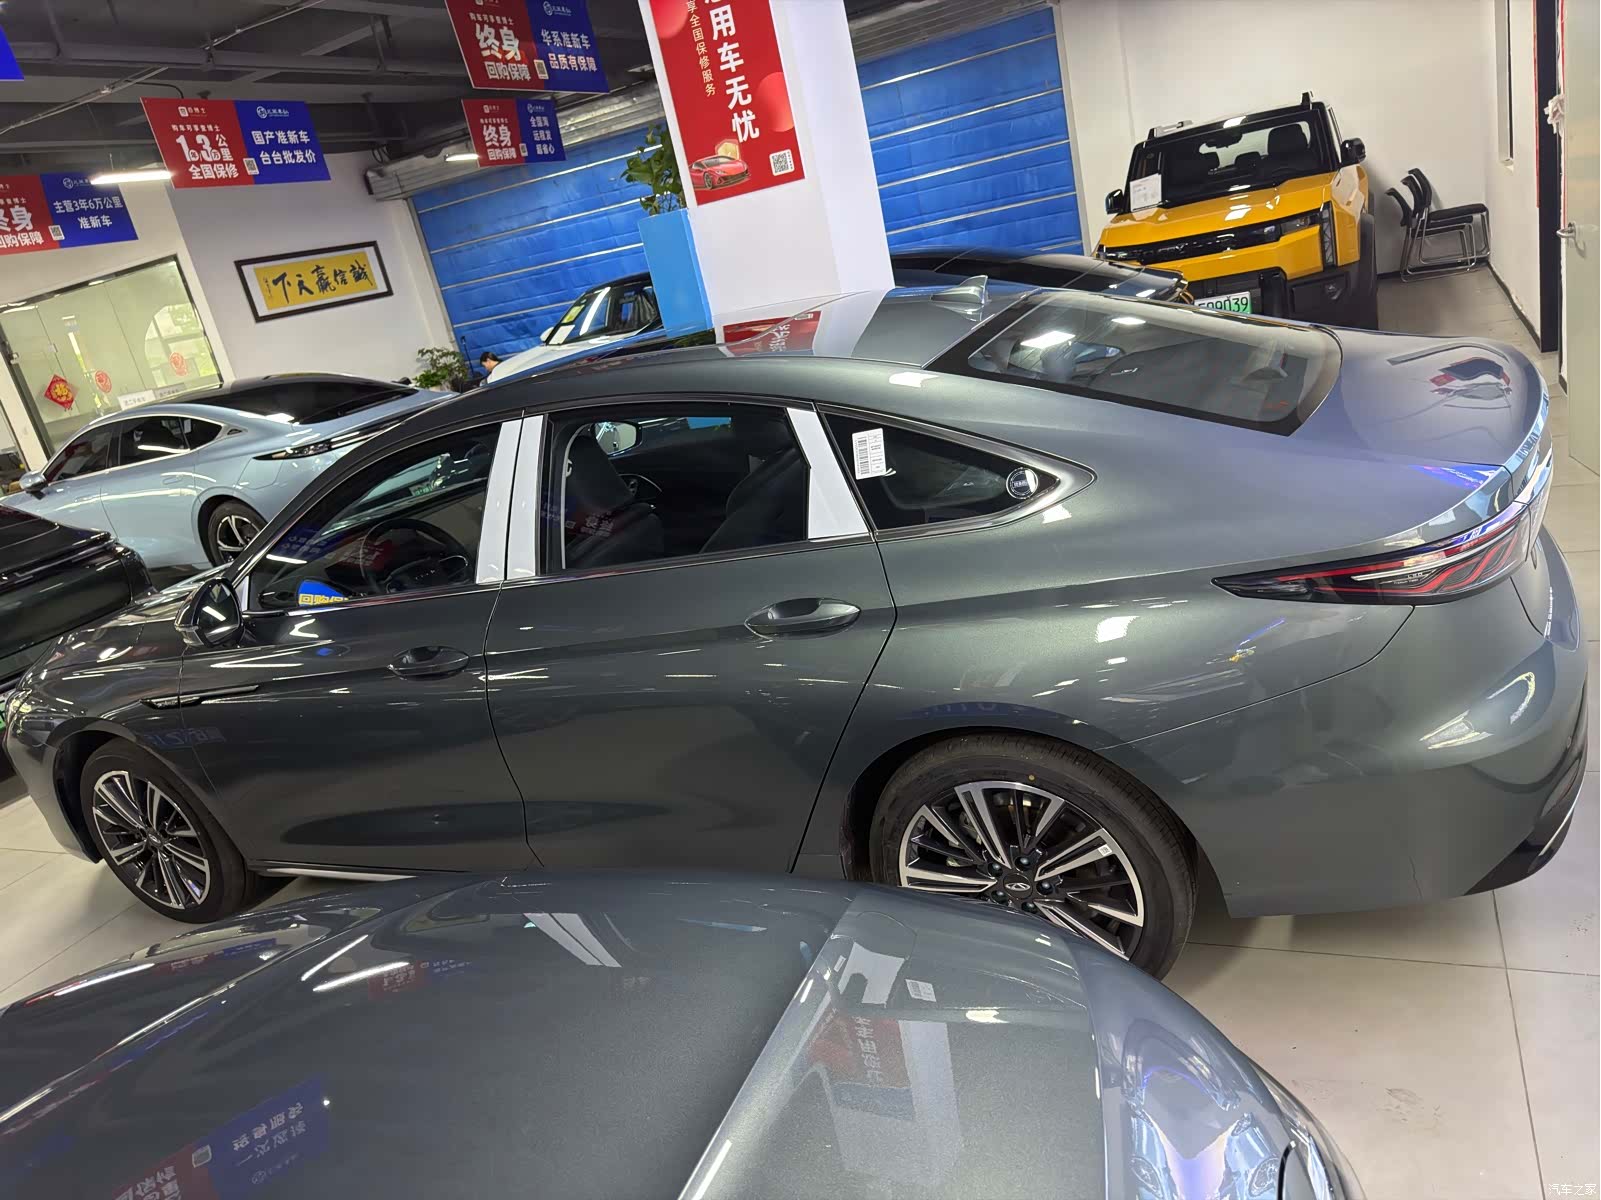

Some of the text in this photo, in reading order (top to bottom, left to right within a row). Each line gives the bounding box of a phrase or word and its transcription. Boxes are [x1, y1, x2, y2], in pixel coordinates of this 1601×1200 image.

[475, 23, 522, 61] 终身
[541, 29, 591, 50] 华系准新车
[485, 61, 531, 81] 回购保障
[548, 53, 597, 72] 品质有保障
[251, 129, 310, 145] 国产准新车
[482, 124, 512, 147] 终身
[259, 149, 317, 165] 台台批发价
[189, 163, 239, 180] 全国保修
[53, 196, 123, 214] 主营3年6万公里
[77, 214, 113, 229] 准新车
